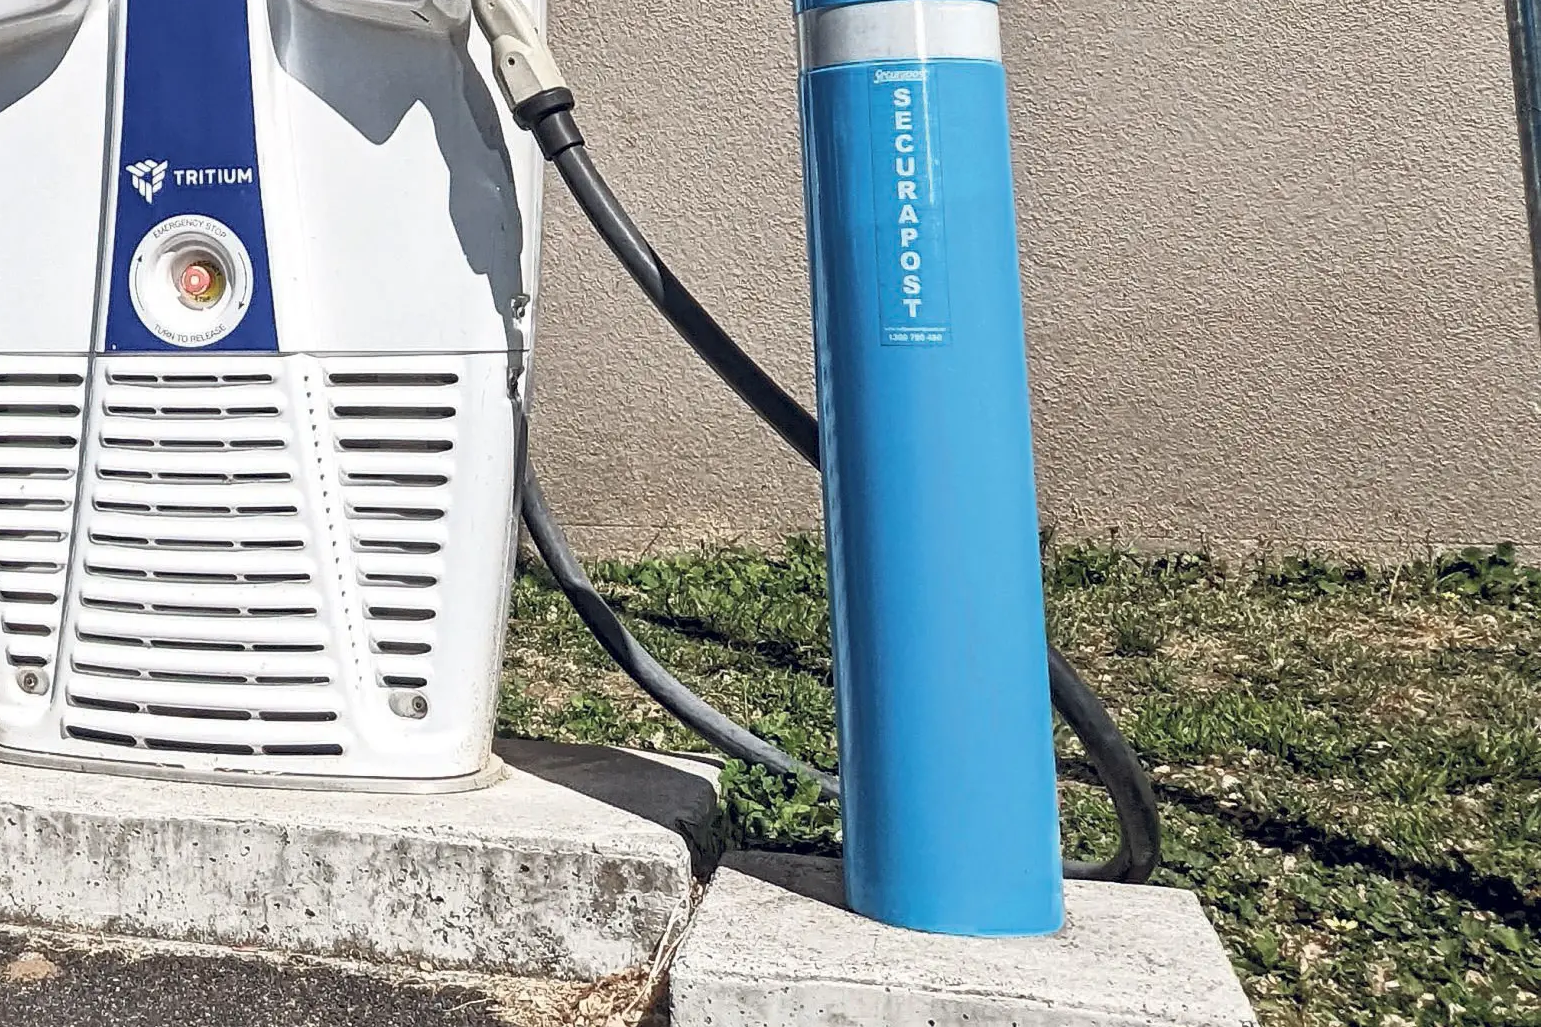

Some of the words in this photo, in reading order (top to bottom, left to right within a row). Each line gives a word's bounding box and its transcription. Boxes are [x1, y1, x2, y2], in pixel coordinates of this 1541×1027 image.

[173, 167, 253, 186] TRITIUM
[893, 88, 922, 318] SECURAPOST
[153, 219, 205, 239] EMERGENCY
[205, 222, 227, 238] STOP
[191, 323, 227, 343] RELEASE
